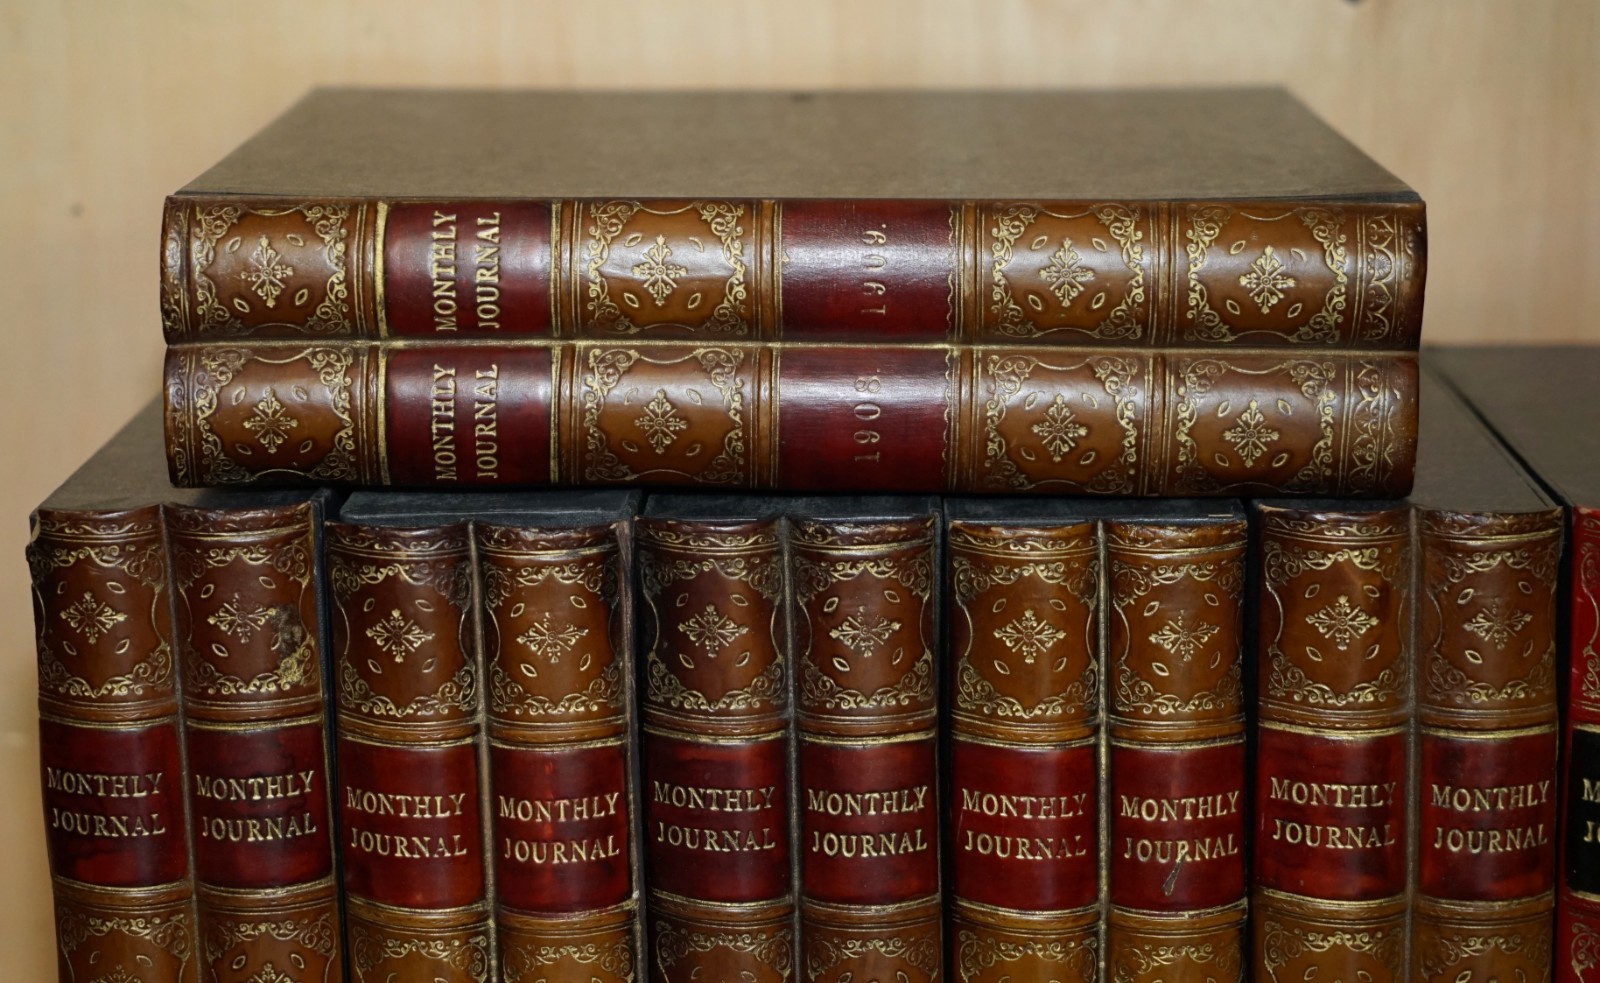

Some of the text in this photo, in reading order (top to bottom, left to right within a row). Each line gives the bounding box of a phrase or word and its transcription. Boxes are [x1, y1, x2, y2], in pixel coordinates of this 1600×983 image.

[432, 210, 457, 331] MONTHLY
[476, 211, 500, 328] JOURNAL
[431, 363, 457, 480] MONTHLY
[475, 364, 498, 478] JOURNAL
[47, 767, 163, 798] MONTHLY
[196, 770, 315, 800] MONTHLY
[653, 780, 775, 812] MONTHLY
[1269, 776, 1396, 808] MONTHLY
[1431, 780, 1550, 812] MONTHLY
[346, 786, 466, 819] MONTHLY
[499, 792, 620, 822] MONTHLY
[807, 785, 928, 816] MONTHLY
[962, 788, 1087, 819] MONTHLY
[1120, 791, 1240, 821] MONTHLY
[52, 808, 166, 837] JOURNAL
[202, 812, 317, 842] JOURNAL
[657, 821, 776, 852] JOURNAL
[1272, 818, 1395, 849] JOURNAL
[351, 827, 467, 858] JOURNAL
[504, 835, 620, 864] JOURNAL
[812, 829, 928, 858] JOURNAL
[964, 830, 1087, 860] JOURNAL
[1124, 833, 1238, 864] JOURNAL
[1434, 823, 1548, 854] JOURNAL
